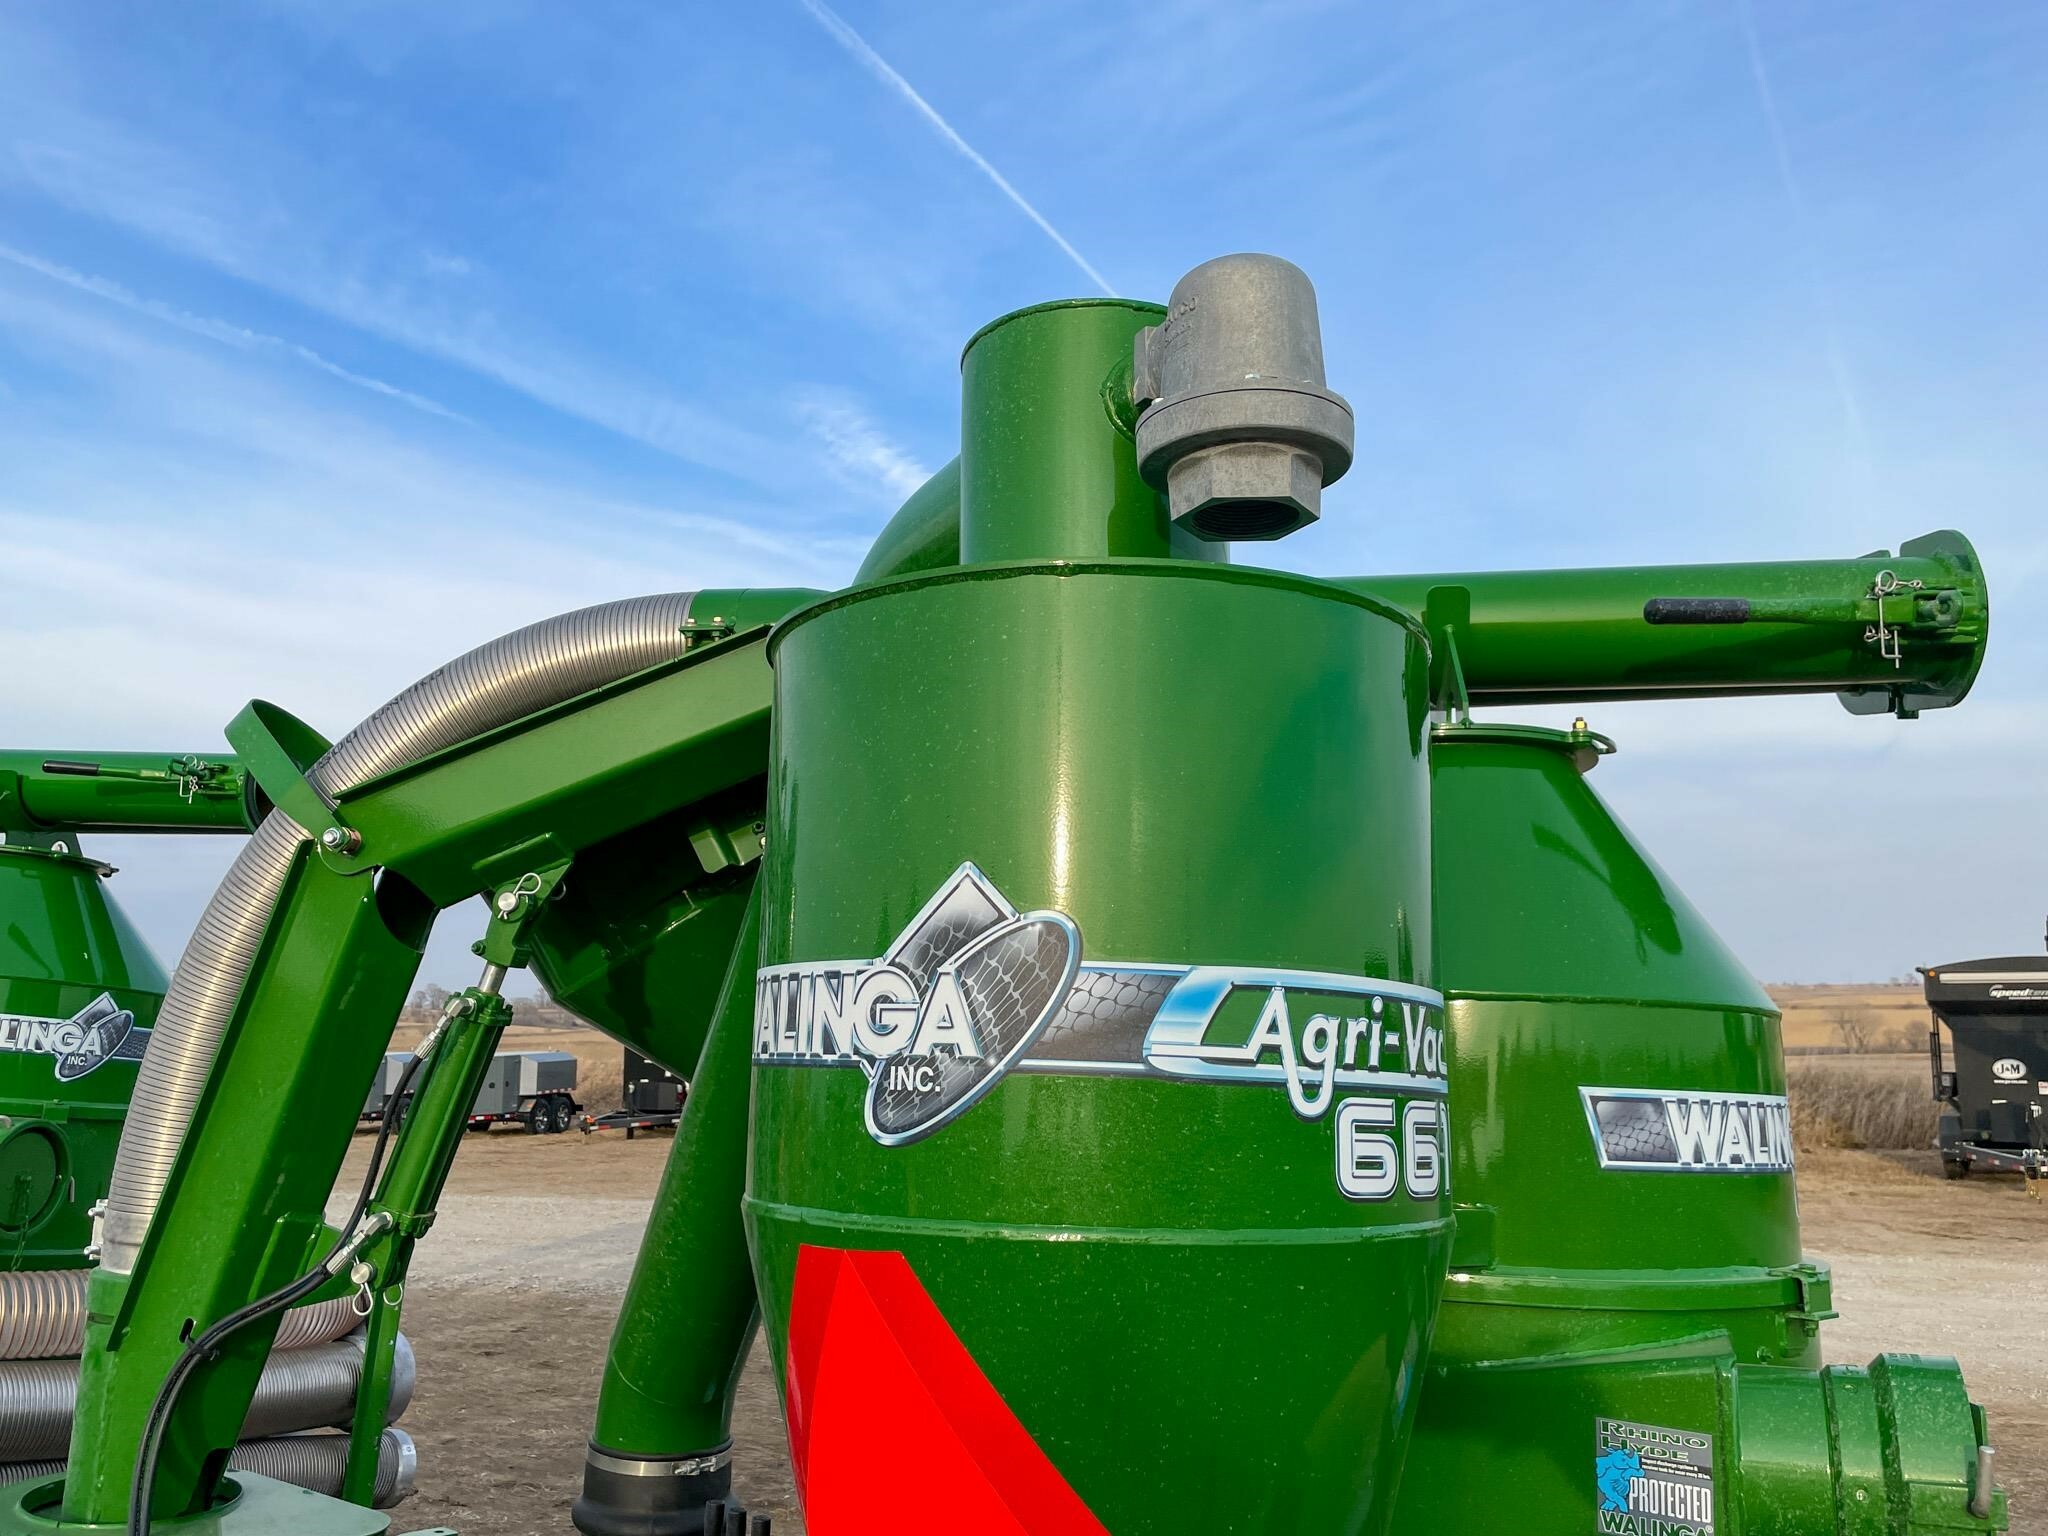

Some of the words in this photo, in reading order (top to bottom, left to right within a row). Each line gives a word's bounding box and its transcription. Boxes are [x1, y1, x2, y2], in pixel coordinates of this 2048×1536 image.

[754, 967, 984, 1059] ALINGA
[0, 1018, 102, 1055] LINGA
[67, 1055, 88, 1066] INC.
[889, 1065, 941, 1092] INC.
[1663, 1099, 1792, 1165] WALIN
[1600, 1420, 1708, 1449] RHINO
[1601, 1435, 1688, 1462] HYDE
[1629, 1476, 1712, 1523] PROTECTED
